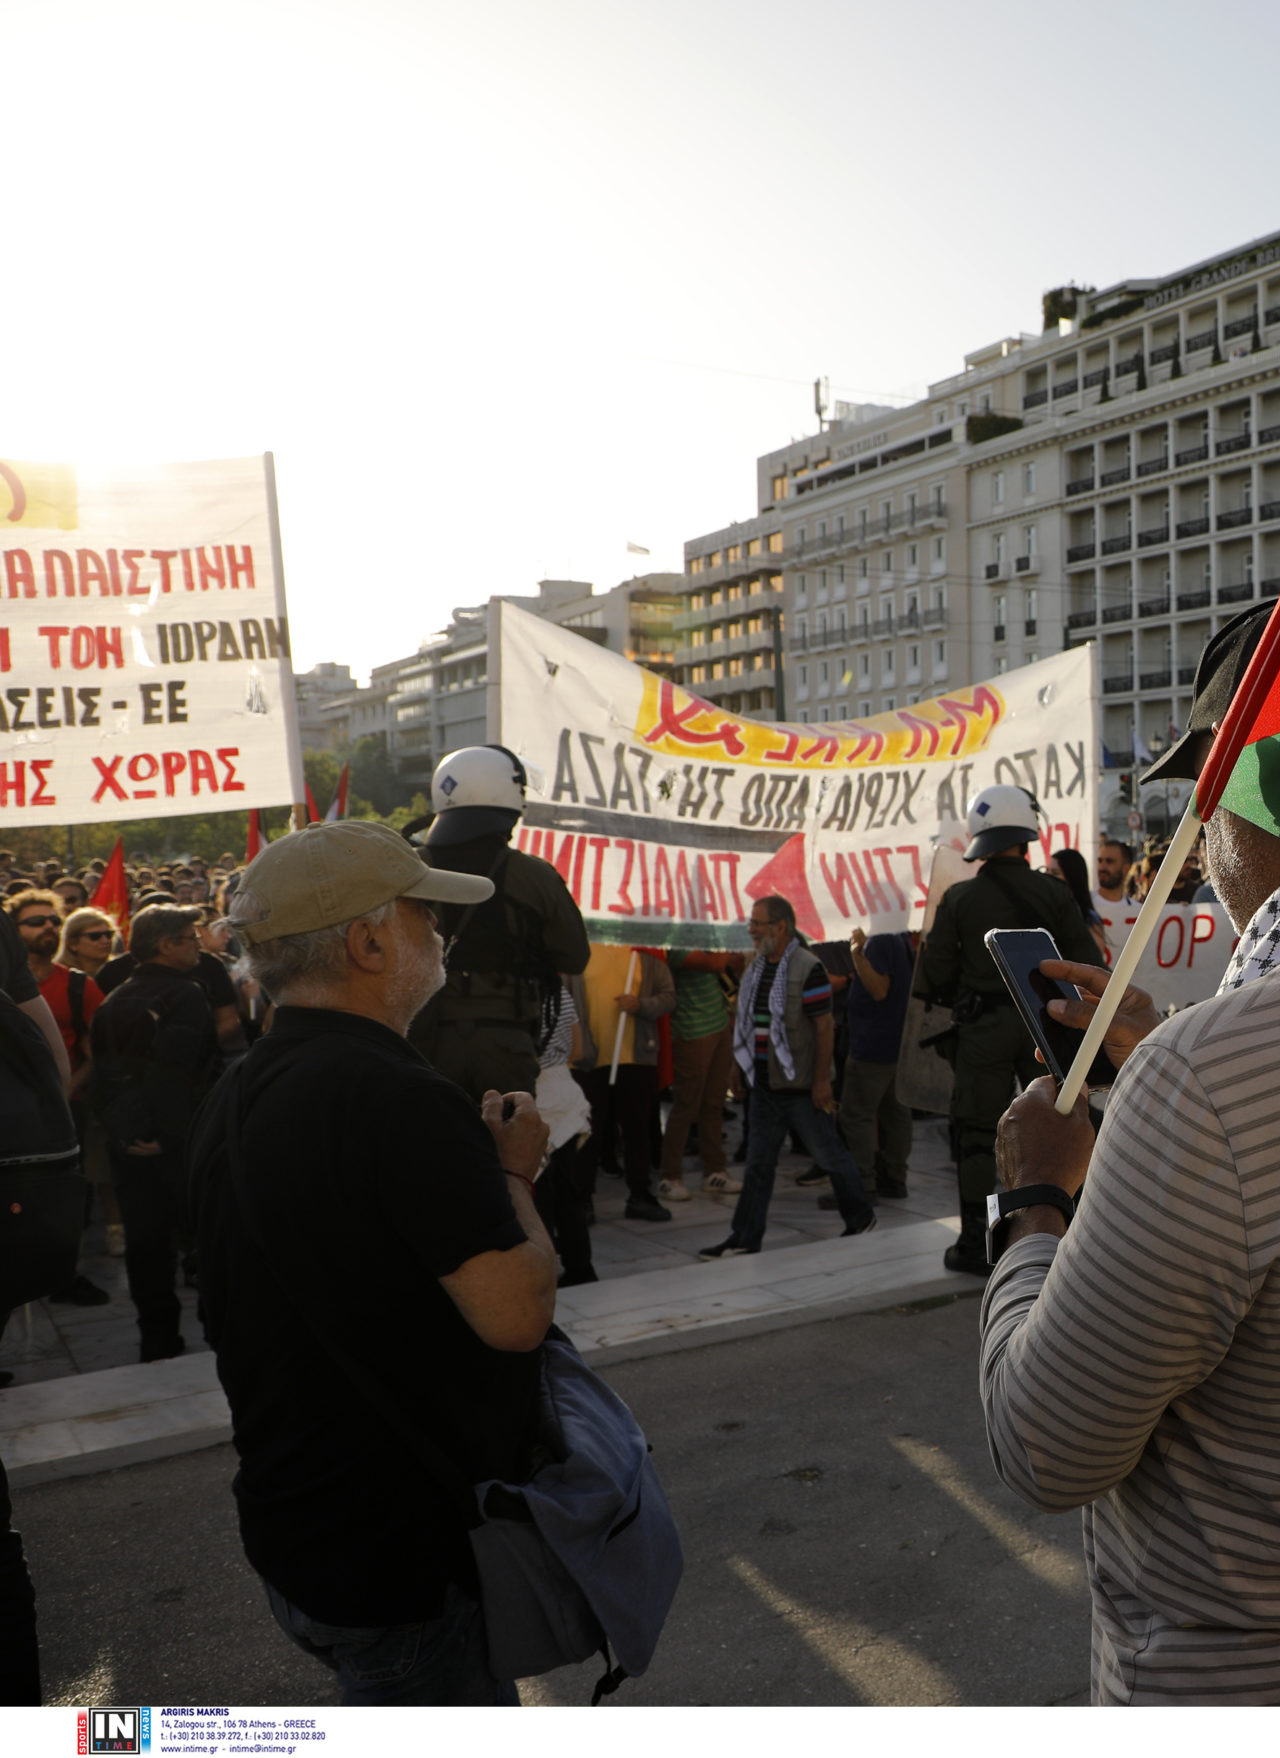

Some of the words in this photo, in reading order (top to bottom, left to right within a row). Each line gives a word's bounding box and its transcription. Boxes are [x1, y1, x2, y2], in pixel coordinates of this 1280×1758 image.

[0, 545, 256, 598] ΑΛΑΙΣΤΙΝΗ
[38, 625, 126, 670] ΤΟΝ
[139, 680, 189, 725] ΕΕ
